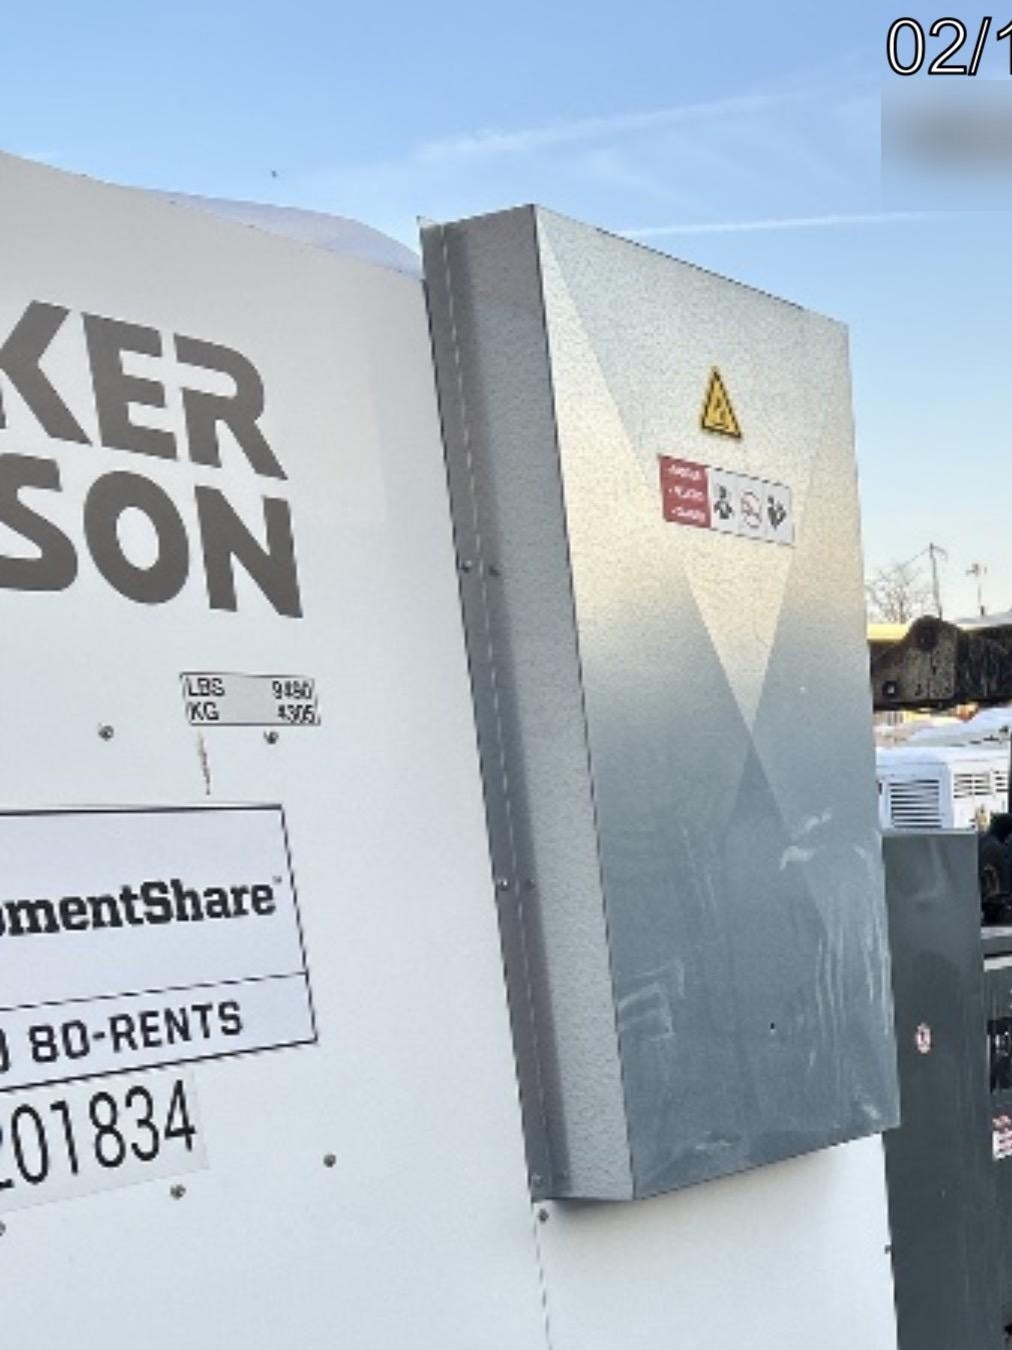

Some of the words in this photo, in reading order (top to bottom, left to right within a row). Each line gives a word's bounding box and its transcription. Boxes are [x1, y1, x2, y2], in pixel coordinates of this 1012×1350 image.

[0, 453, 303, 618] SON
[188, 678, 225, 697] LBS
[190, 702, 219, 721] KG
[0, 878, 276, 935] mentShare
[29, 1000, 243, 1063] 80-RENTS
